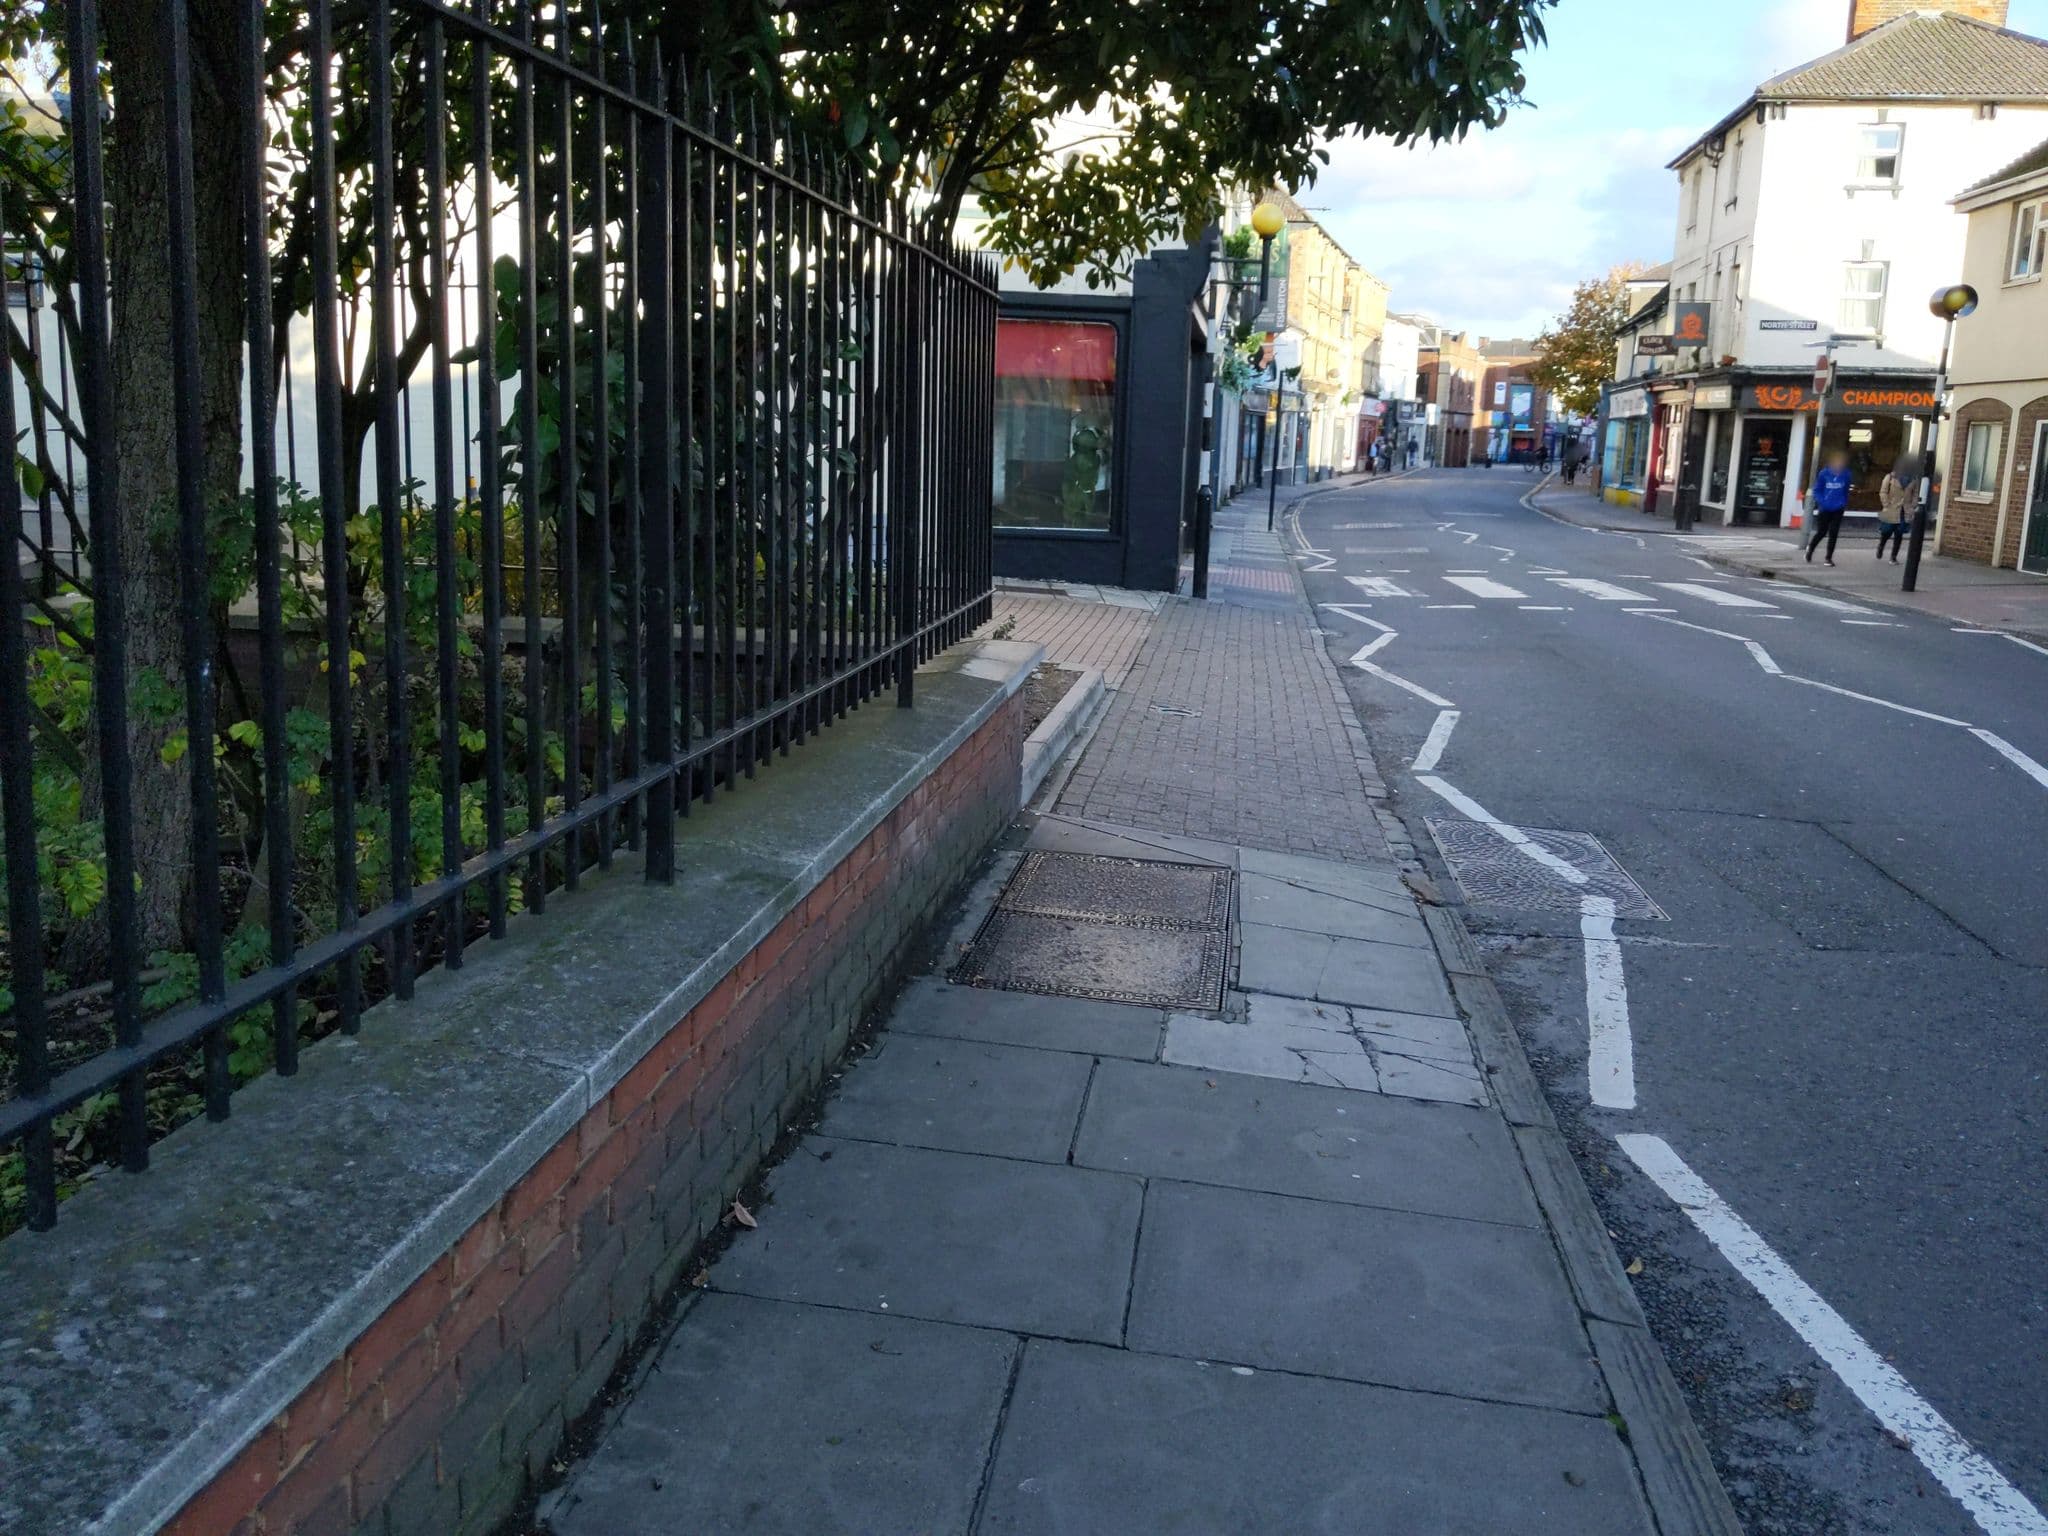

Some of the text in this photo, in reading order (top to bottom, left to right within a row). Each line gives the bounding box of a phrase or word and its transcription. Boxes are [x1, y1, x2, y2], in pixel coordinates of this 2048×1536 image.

[1276, 279, 1287, 328] FISHERTON
[1761, 320, 1816, 329] NORTH STREET
[1842, 389, 1935, 407] CHAMPION
